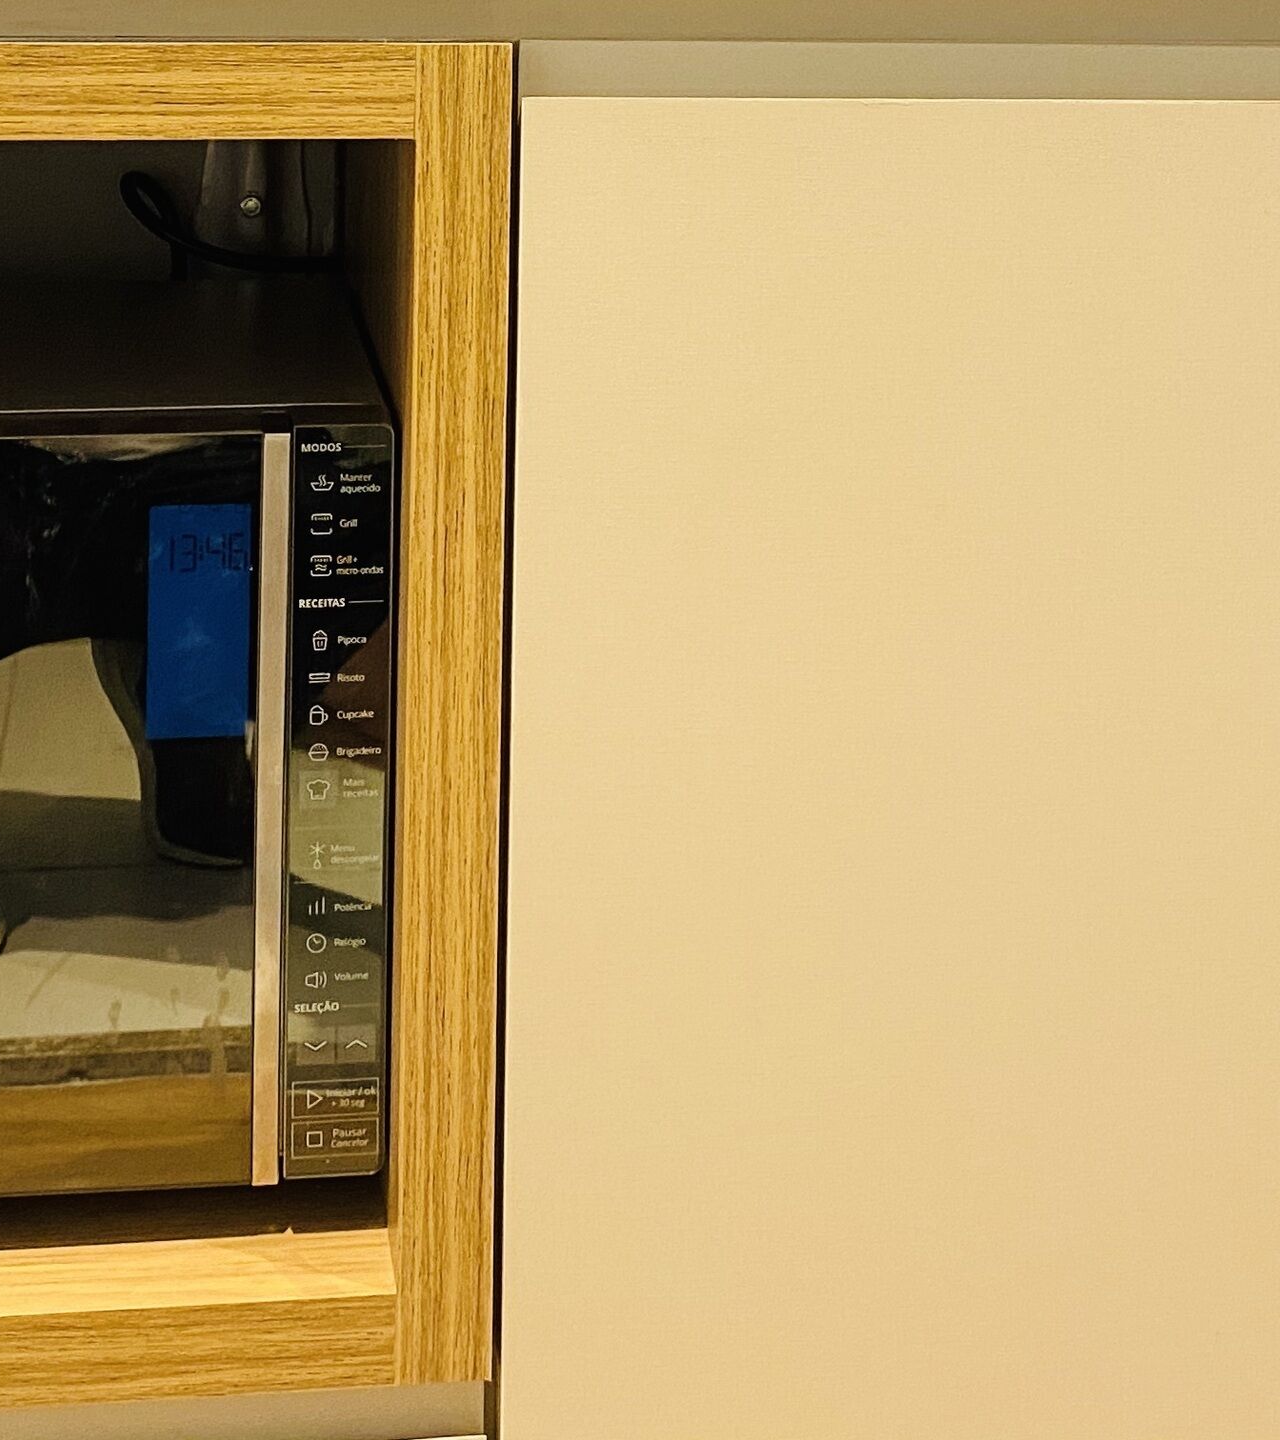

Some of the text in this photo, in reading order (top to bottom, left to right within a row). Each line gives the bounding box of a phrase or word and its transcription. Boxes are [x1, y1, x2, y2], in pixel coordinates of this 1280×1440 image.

[301, 443, 342, 453] MODOS
[339, 473, 372, 482] Manter
[339, 484, 381, 494] aquecido
[339, 519, 358, 528] Grill
[336, 566, 384, 576] micro-ondas
[299, 598, 346, 609] RECEITAS
[337, 635, 368, 645] Pipoca
[337, 673, 365, 682] Risoto
[336, 709, 375, 720] Cupcake
[336, 747, 382, 758] Brigadeiro
[334, 936, 366, 948] Relógio
[334, 972, 369, 981] Volume
[294, 1000, 340, 1014] SELEÇÃO
[332, 1128, 368, 1138] Pausar
